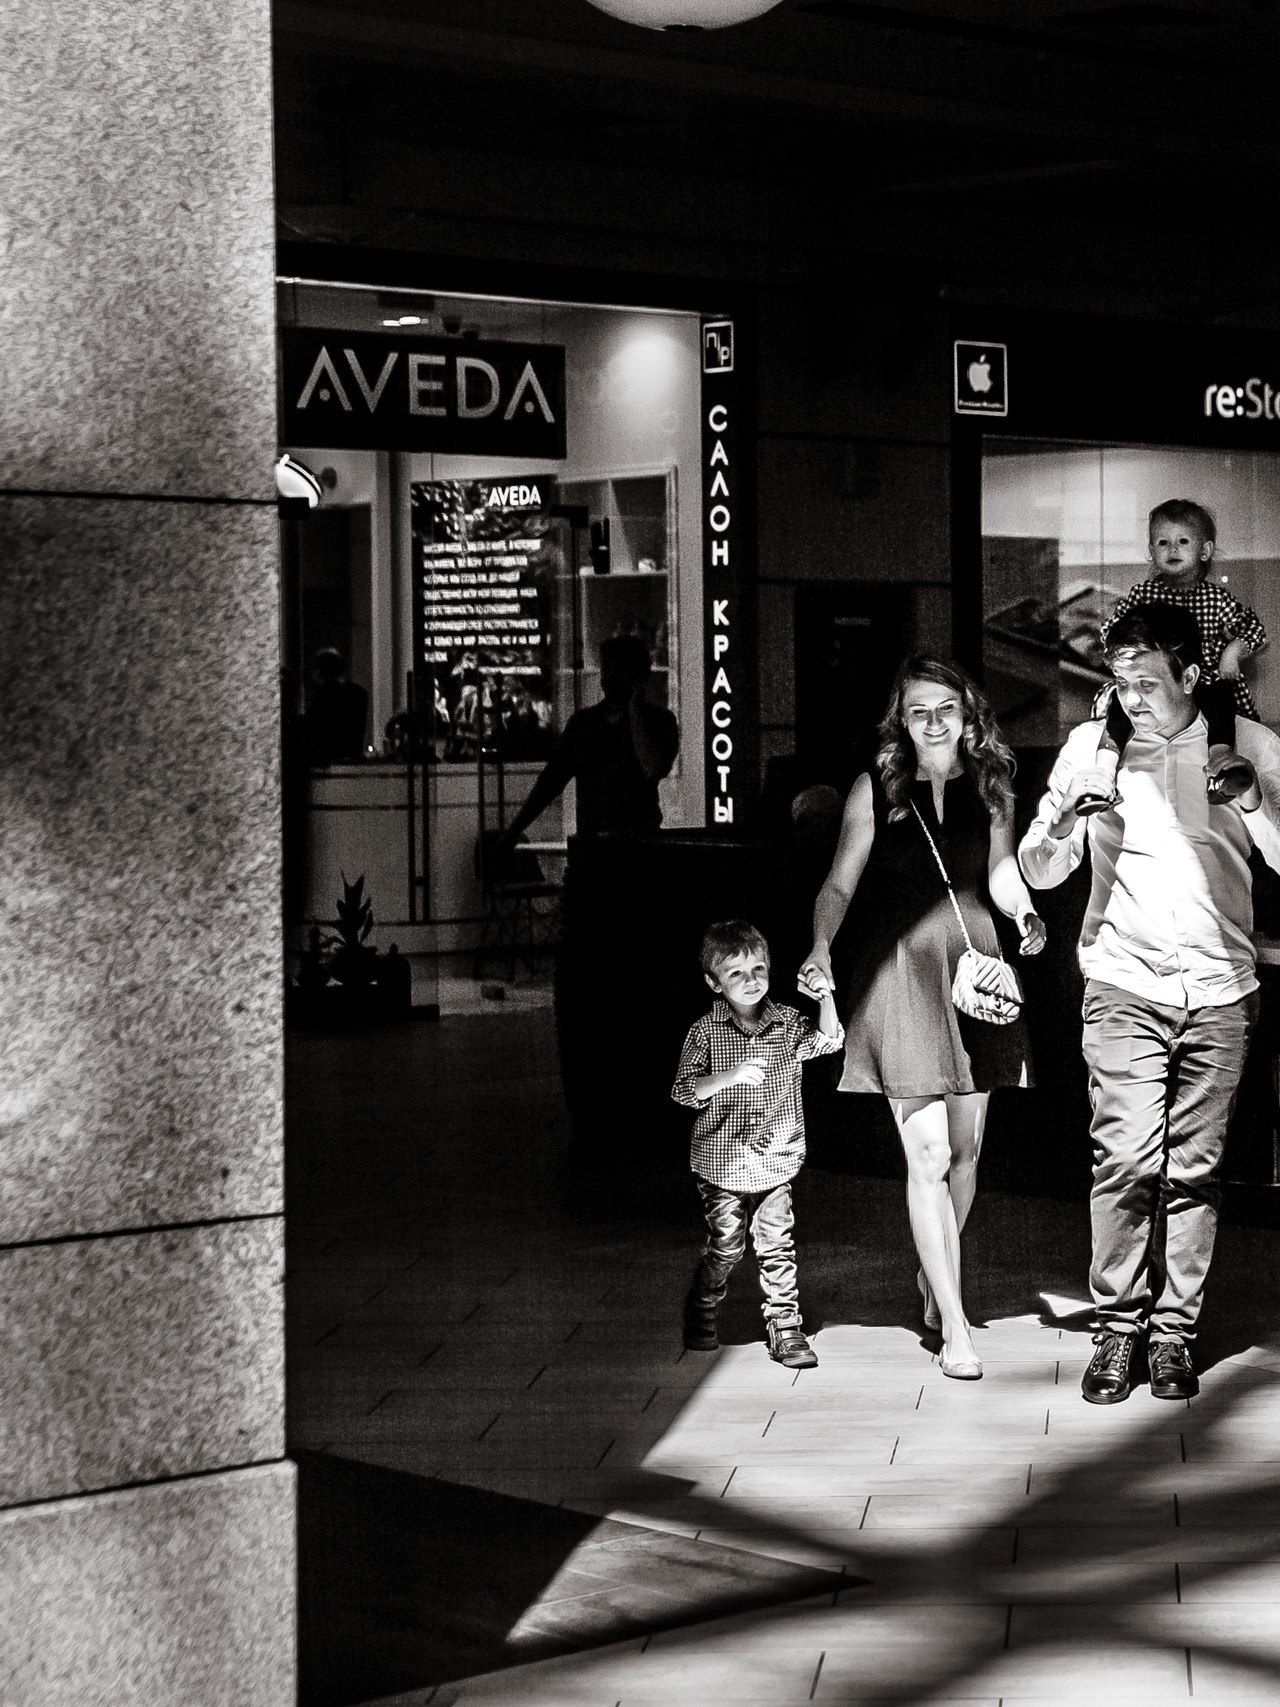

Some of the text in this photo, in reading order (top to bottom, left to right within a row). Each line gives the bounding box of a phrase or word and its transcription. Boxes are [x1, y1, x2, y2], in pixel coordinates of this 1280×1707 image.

[296, 345, 555, 423] AVEDA
[487, 484, 542, 507] AVEDA
[708, 404, 734, 824] САЛОН КРАСОТЫ
